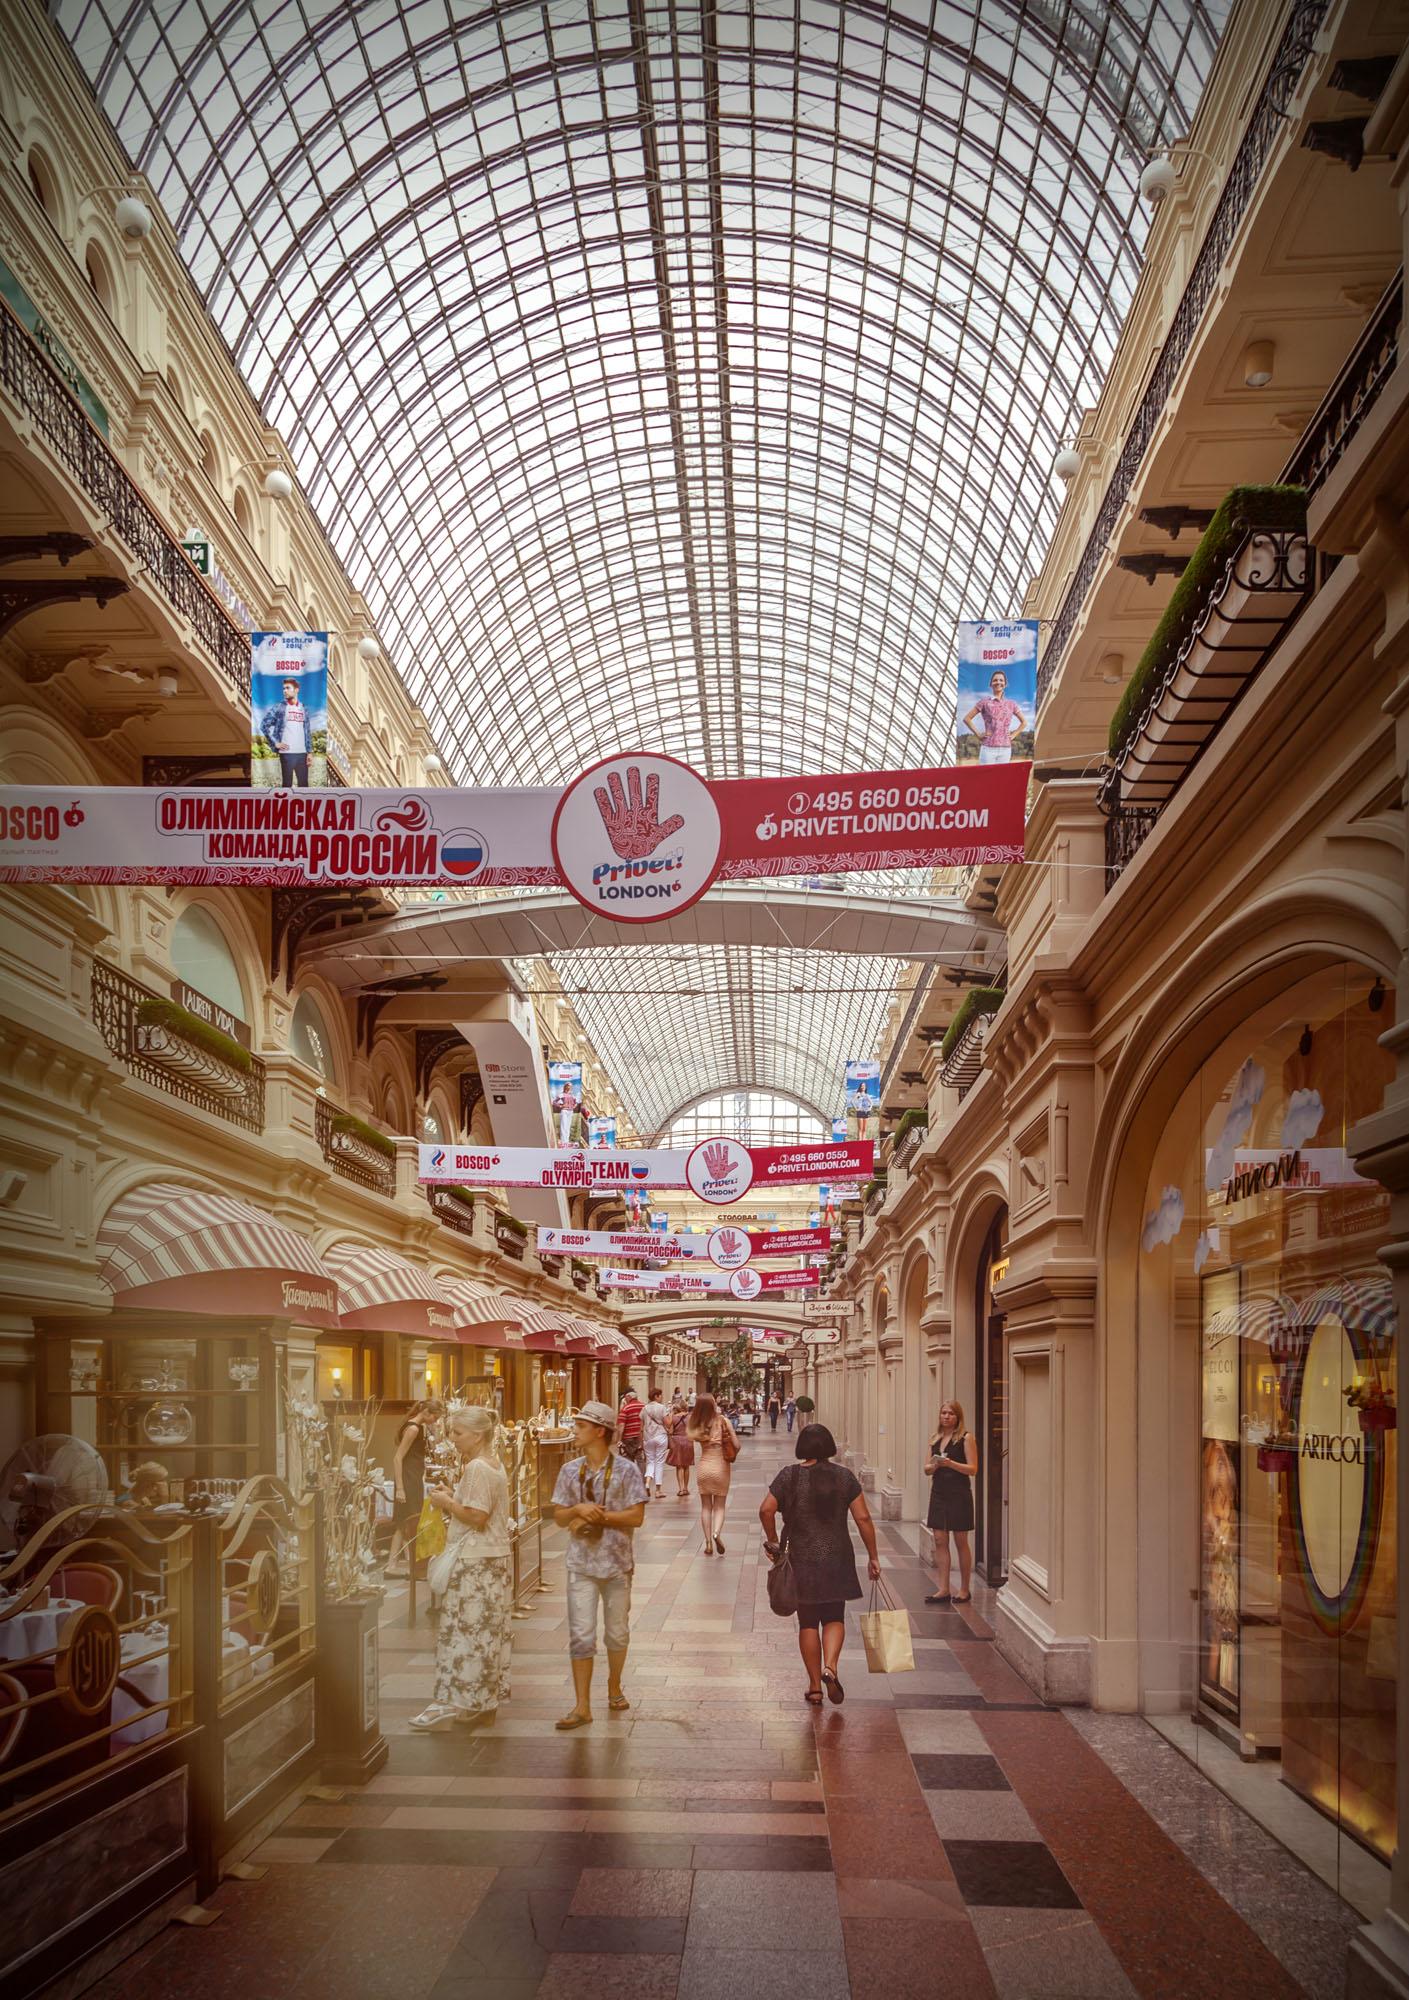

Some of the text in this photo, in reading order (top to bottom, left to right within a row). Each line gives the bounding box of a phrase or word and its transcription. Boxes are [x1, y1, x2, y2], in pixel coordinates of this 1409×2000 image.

[983, 649, 1008, 660] BOSCO
[276, 660, 300, 670] BOSCO
[812, 785, 960, 810] 495 660 0550
[161, 792, 356, 830] ОЛИМПИЙСКАЯ
[780, 808, 989, 839] PRIVETLONDON.COM
[209, 833, 438, 876] КОМАНДА РОССИИ
[592, 846, 685, 886] Privet!
[599, 884, 672, 899] LONDON
[214, 1006, 239, 1043] VIDAL
[501, 1064, 526, 1072] Store
[456, 1154, 490, 1170] BOSCO
[789, 1150, 848, 1163] 495 660 0550
[553, 1160, 585, 1171] RUSSIAN
[777, 1159, 860, 1173] PRIVETLONDON.COM
[542, 1161, 630, 1186] OLYMPIC TEAM
[561, 1235, 584, 1245] BOSCO
[610, 1234, 660, 1245] ОЛИМПИЙСКАЯ
[648, 1246, 682, 1258] РОССИИ
[683, 1278, 702, 1287] TEAM
